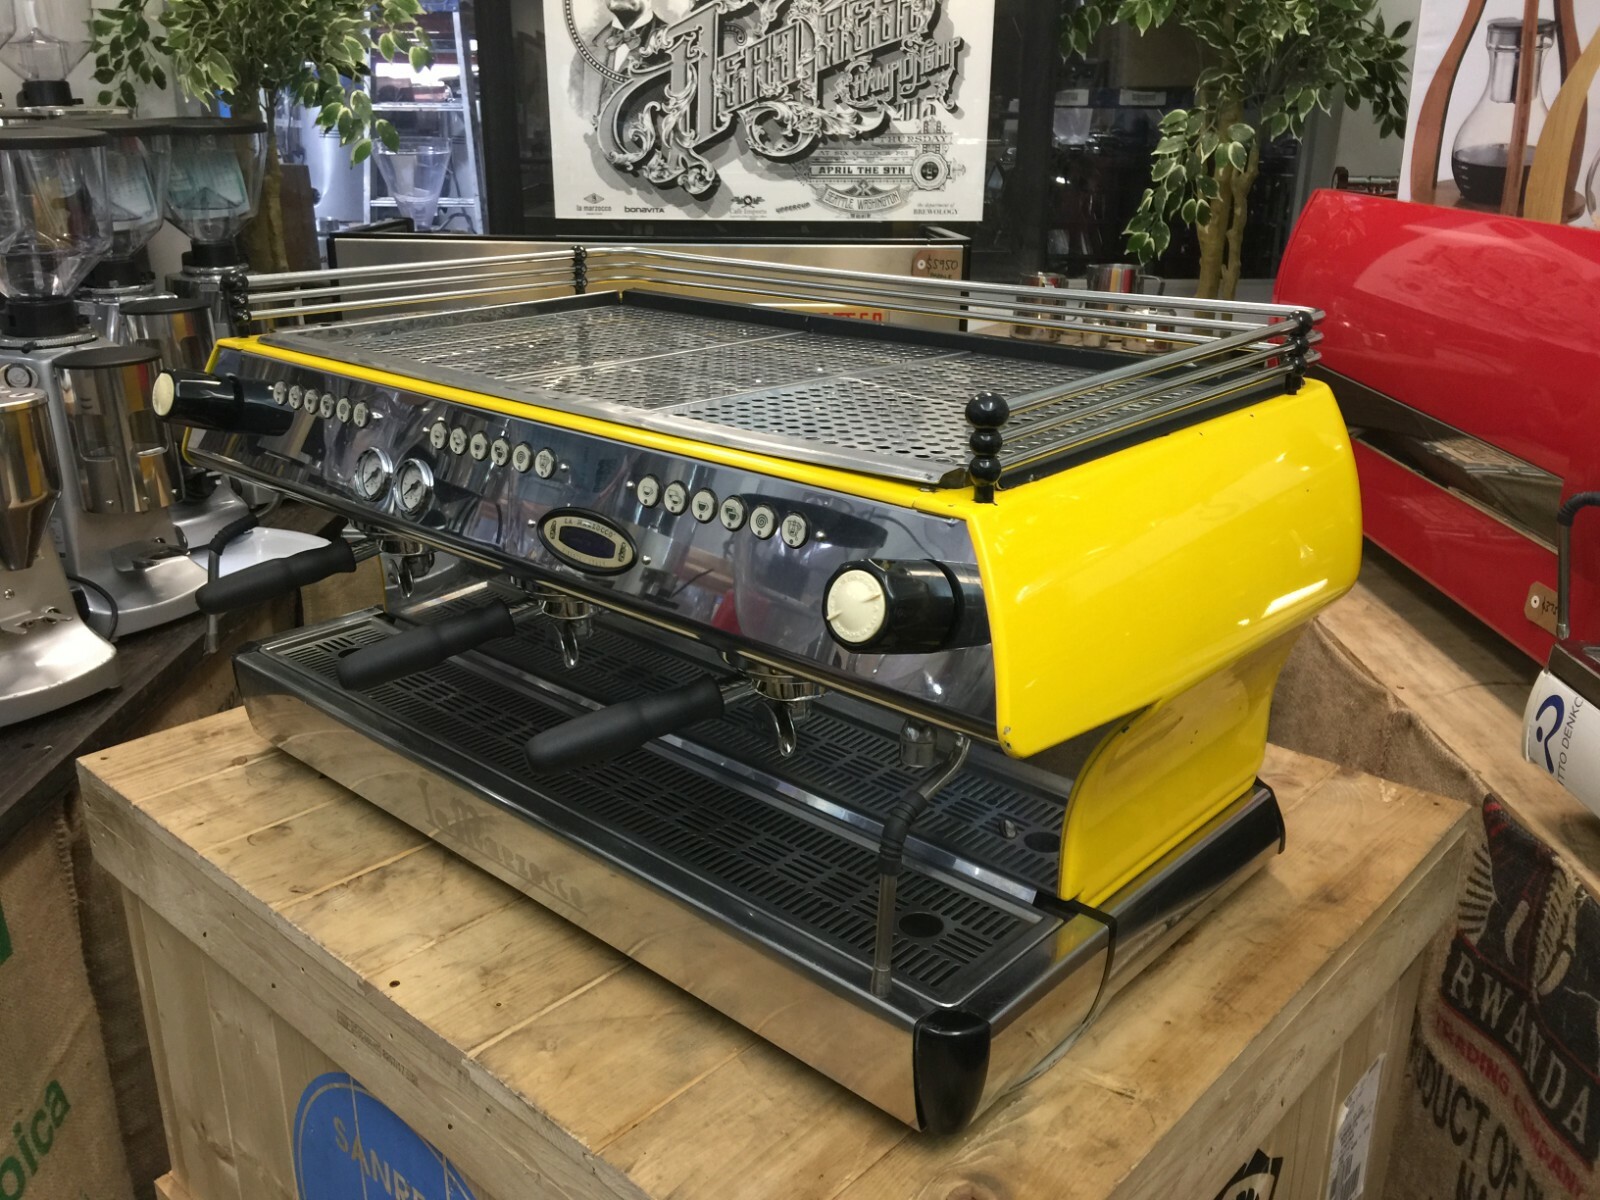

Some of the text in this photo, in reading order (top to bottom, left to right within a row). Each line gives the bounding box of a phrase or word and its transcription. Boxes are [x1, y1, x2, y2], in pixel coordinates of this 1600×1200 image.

[880, 135, 947, 144] THURSDAY
[818, 166, 906, 175] APRIL THE 9TH
[825, 190, 900, 211] SEATTLE WASHINGTON
[1450, 951, 1592, 1145] RWANDA
